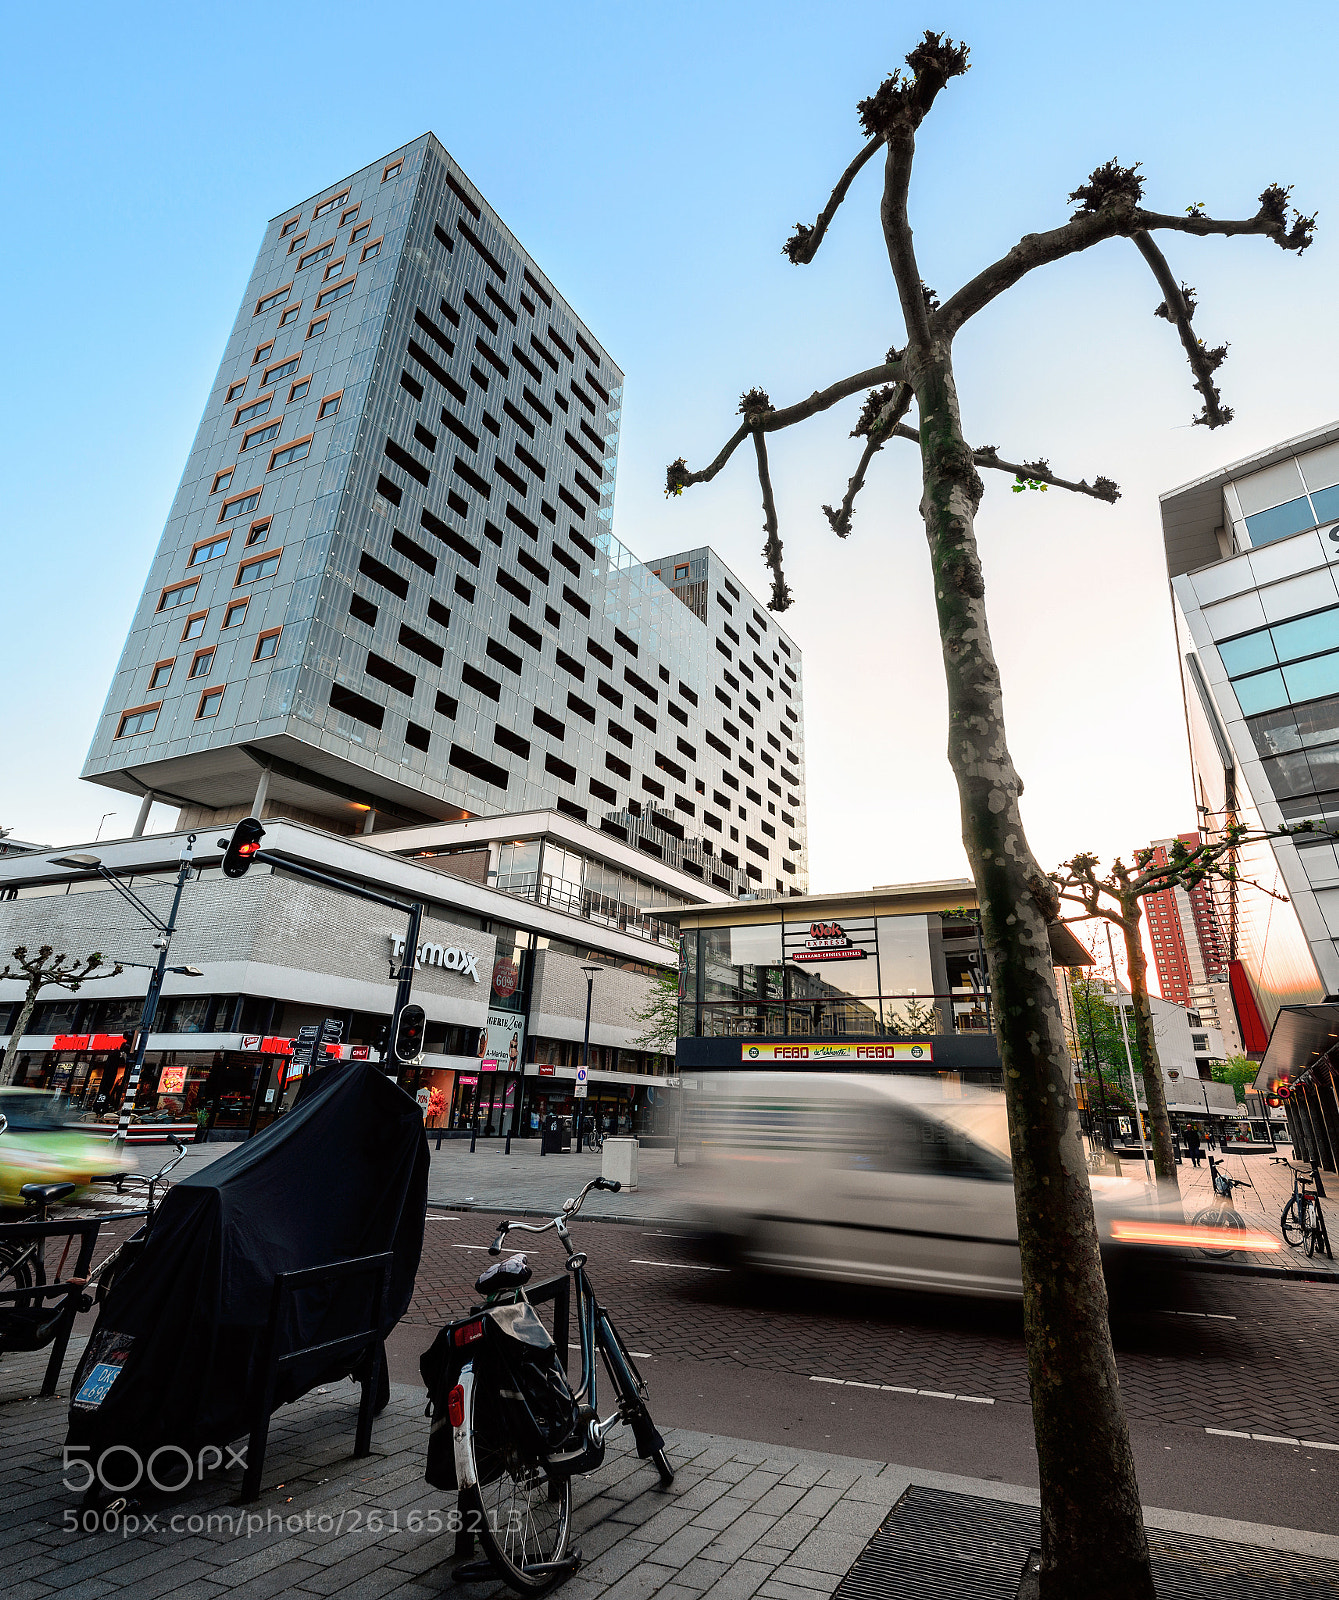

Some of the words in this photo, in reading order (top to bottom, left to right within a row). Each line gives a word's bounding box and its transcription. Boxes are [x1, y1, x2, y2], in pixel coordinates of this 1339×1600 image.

[810, 922, 842, 937] Wok
[807, 938, 845, 947] EXPRESS
[496, 974, 514, 988] 60%
[774, 1047, 809, 1059] FEBO
[857, 1046, 895, 1059] FEBO
[417, 1094, 428, 1103] 70%
